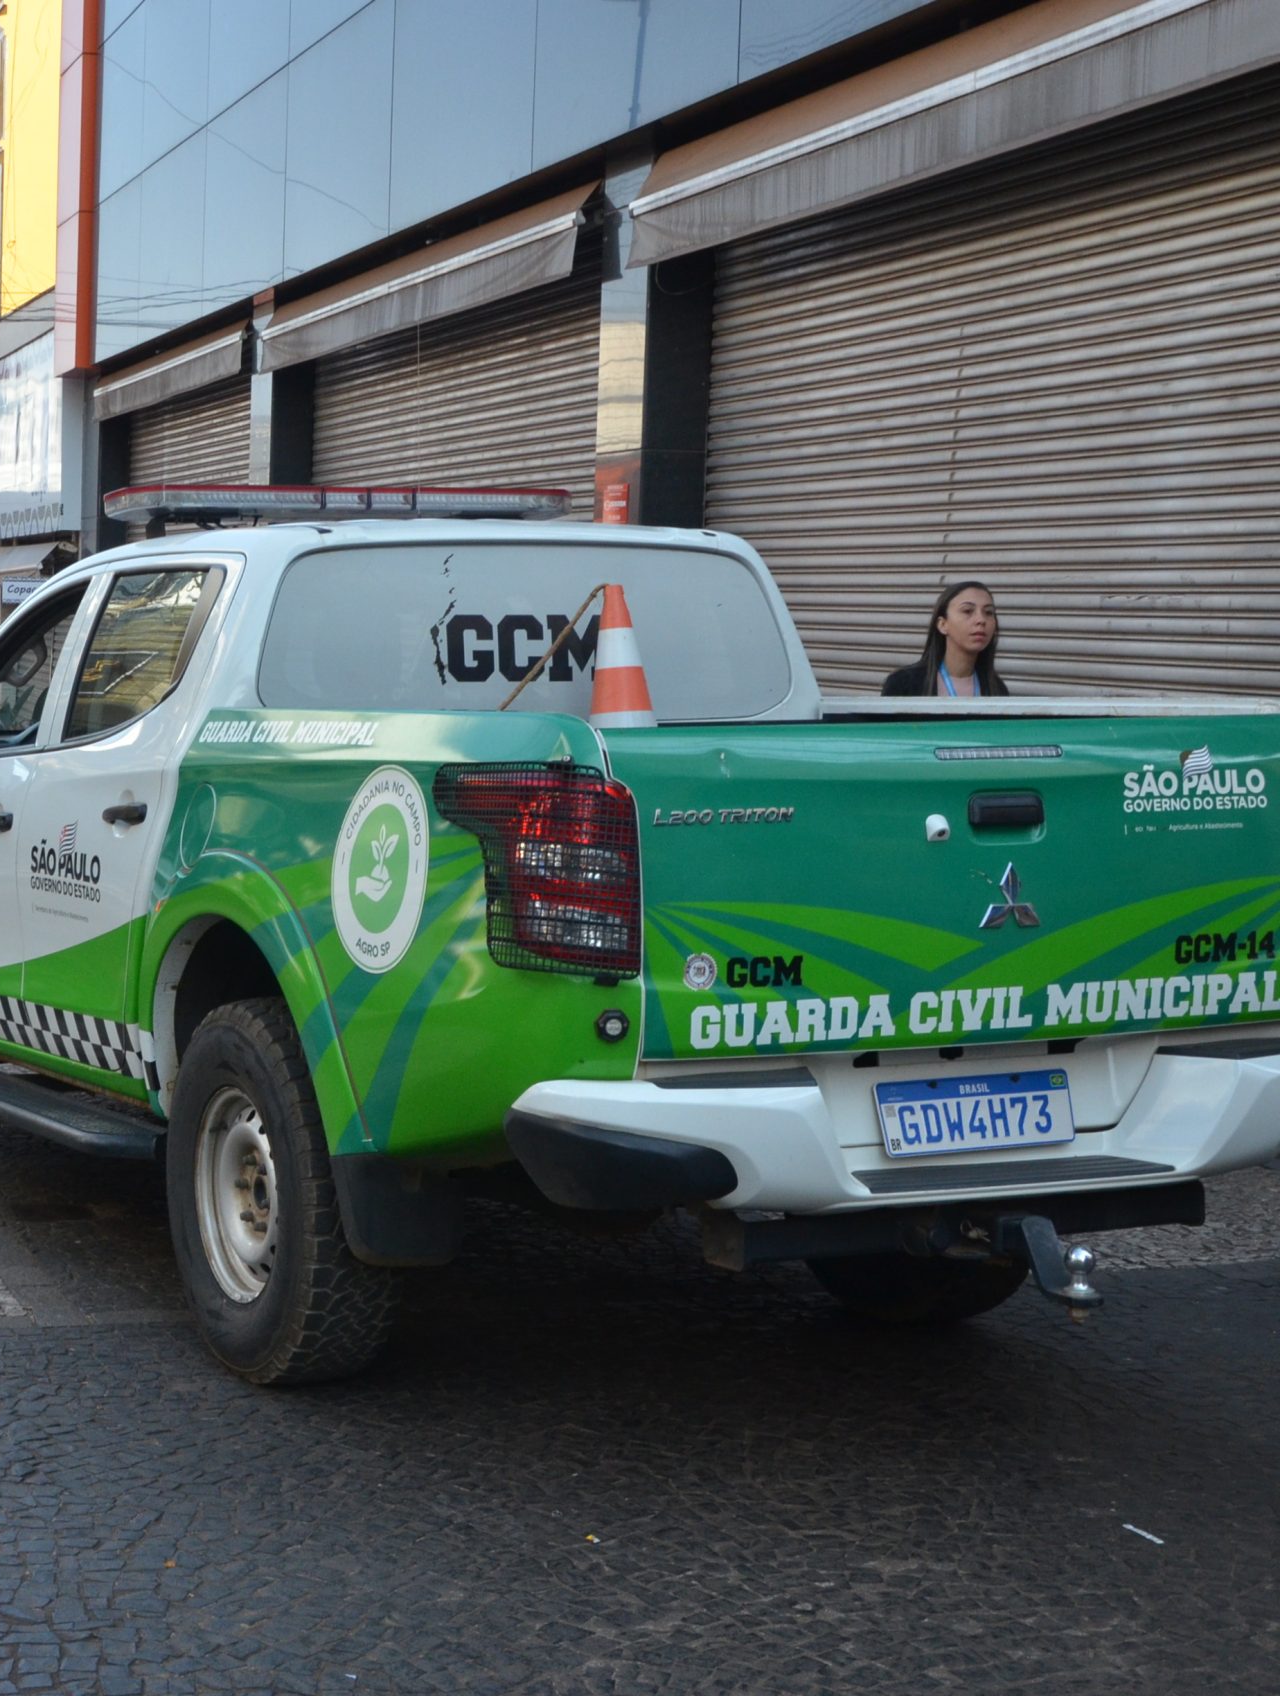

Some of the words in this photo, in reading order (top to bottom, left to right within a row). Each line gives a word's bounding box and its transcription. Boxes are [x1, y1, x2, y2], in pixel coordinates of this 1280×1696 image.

[446, 614, 601, 682] GCM
[198, 720, 256, 743] GUARDA
[252, 720, 294, 744] CIVIL
[289, 721, 379, 746] MUNICIPAL
[1123, 764, 1179, 798] SÃO
[1182, 768, 1265, 796] PAULO
[346, 780, 390, 840] CIDADANIA
[391, 781, 405, 797] NO
[404, 793, 422, 847] CAMPO
[652, 808, 714, 826] L200
[718, 806, 795, 824] TRITON
[1123, 797, 1191, 813] GOVERNO
[1193, 796, 1214, 810] DO
[1216, 795, 1268, 810] ESTADO
[30, 838, 56, 876] SÃO
[58, 852, 101, 884] PAULO
[30, 876, 62, 894] GOVERNO
[62, 883, 73, 897] DO
[74, 885, 101, 903] ESTADO
[355, 937, 379, 958] AGRO
[380, 940, 391, 957] SP
[1175, 930, 1276, 964] GCM-14
[726, 955, 804, 988] GCM
[690, 994, 896, 1050] GUARDA
[909, 986, 1033, 1035] CIVIL
[1044, 970, 1280, 1026] MUNICIPAL
[959, 1083, 991, 1095] BRASIL
[897, 1094, 1053, 1146] GDW4H73
[890, 1138, 903, 1151] BR
